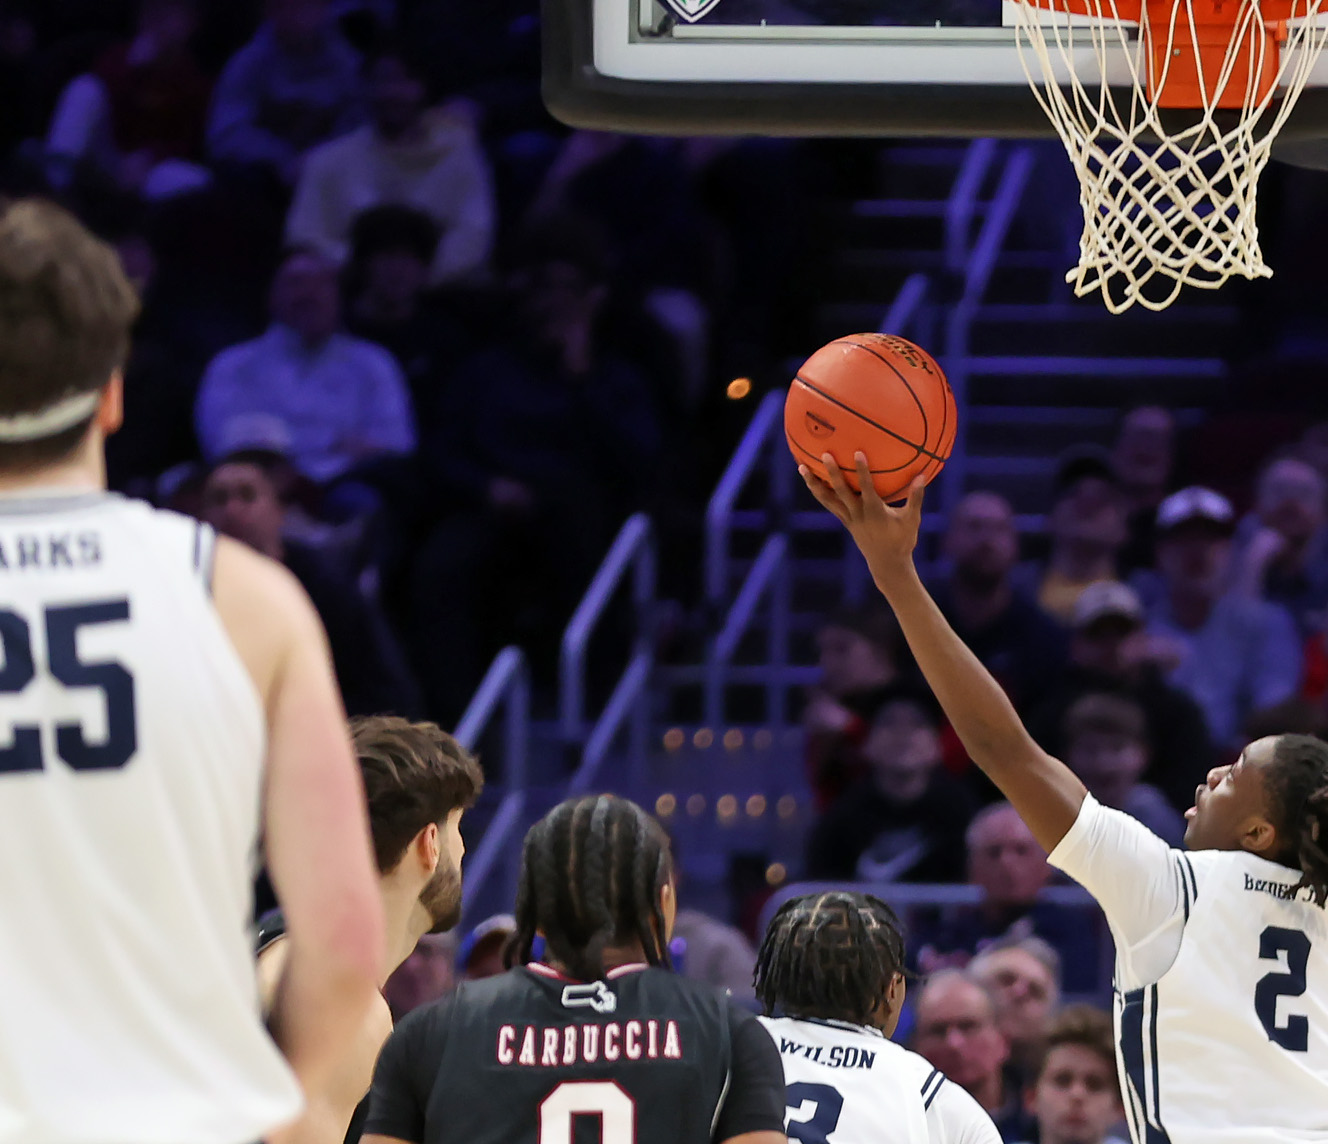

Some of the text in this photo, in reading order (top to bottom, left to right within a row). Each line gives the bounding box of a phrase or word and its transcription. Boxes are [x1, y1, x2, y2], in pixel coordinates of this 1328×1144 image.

[1254, 925, 1312, 1053] 2
[497, 1020, 682, 1067] CARBUCCIA
[780, 1037, 877, 1070] WILSON
